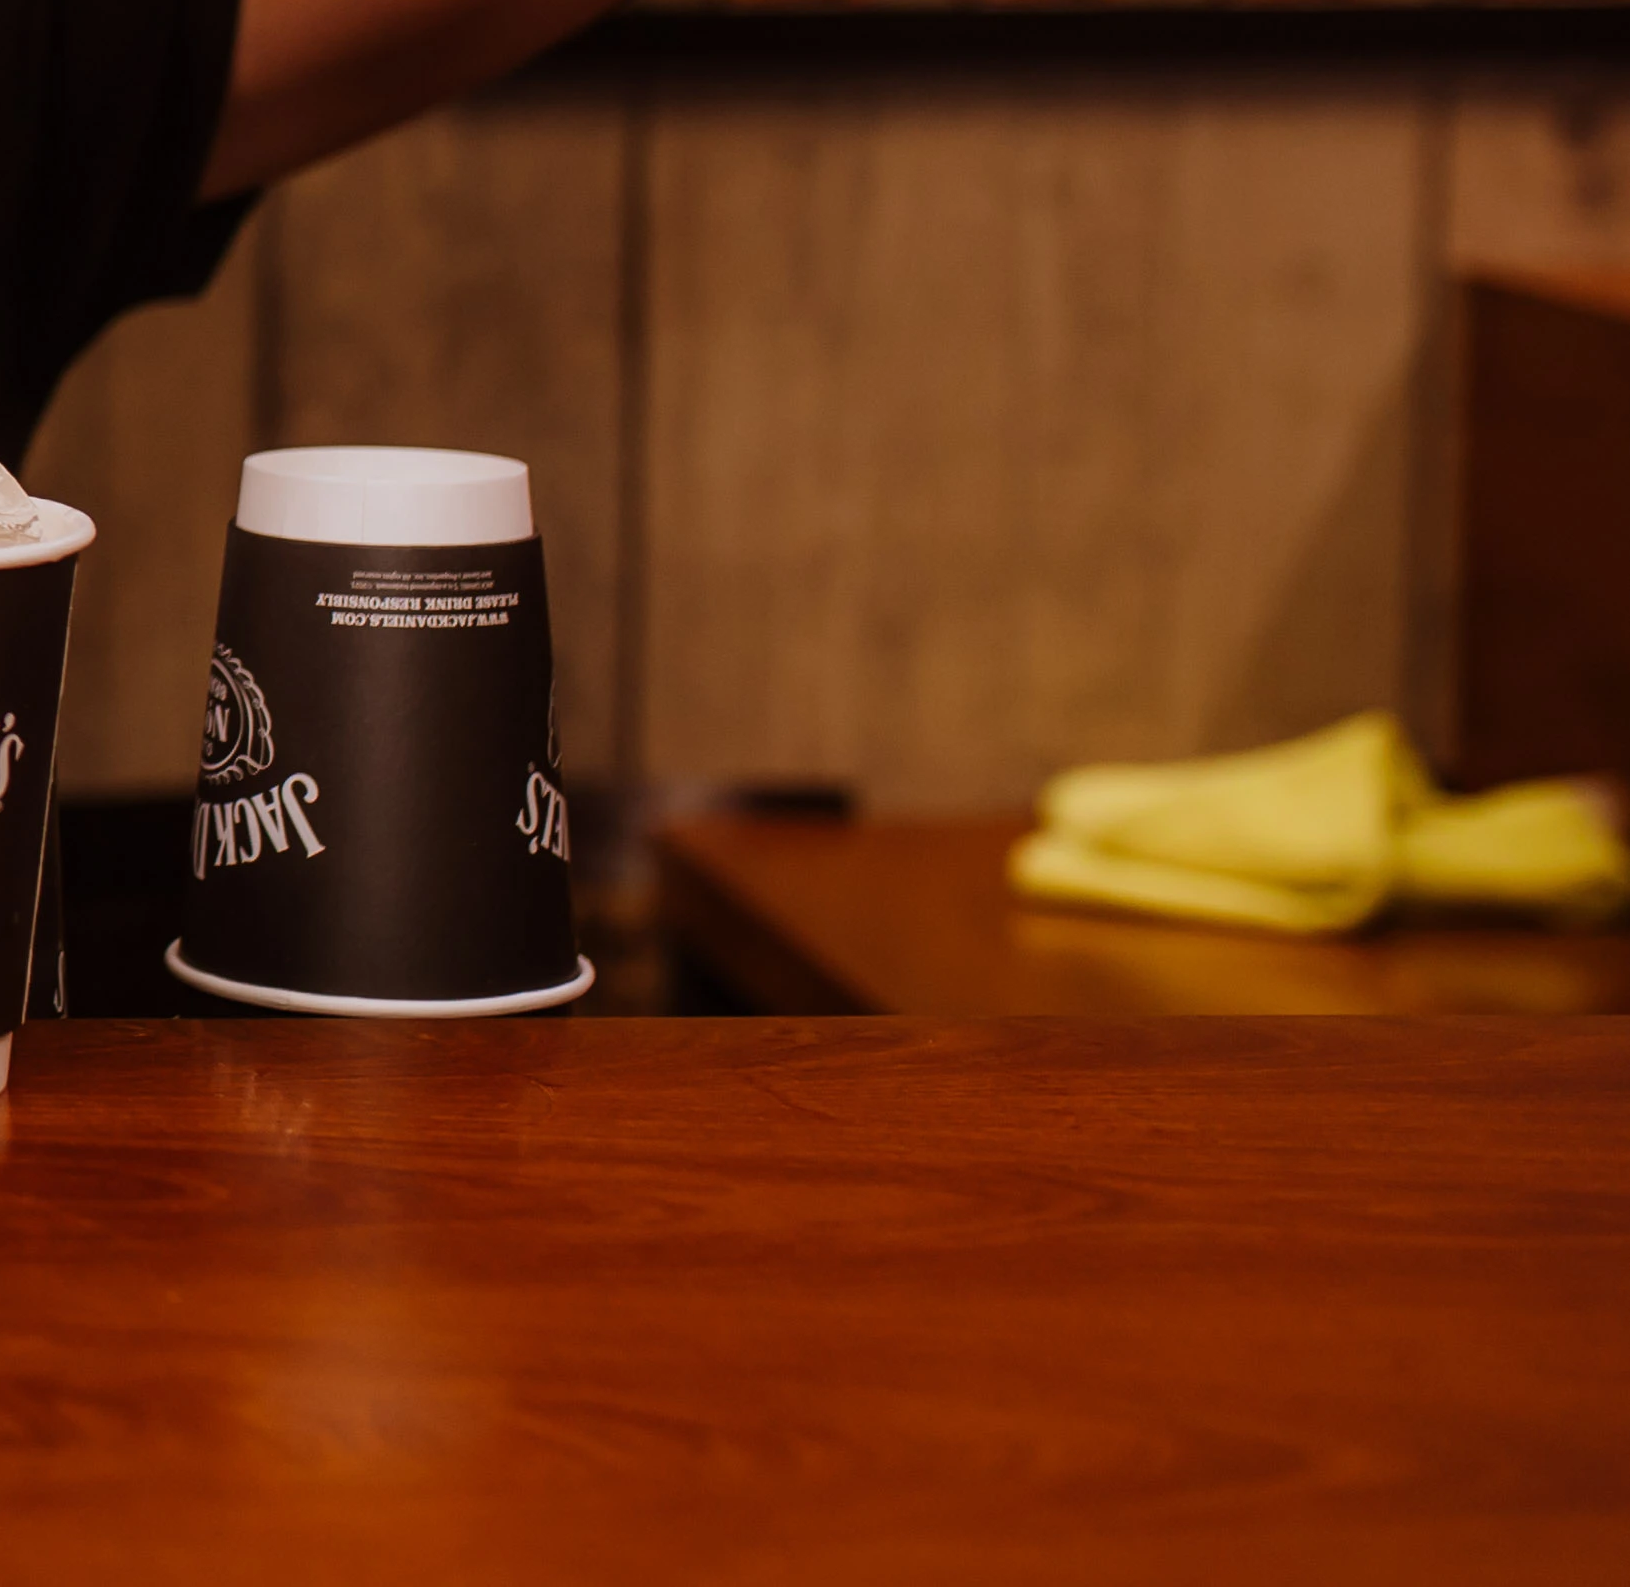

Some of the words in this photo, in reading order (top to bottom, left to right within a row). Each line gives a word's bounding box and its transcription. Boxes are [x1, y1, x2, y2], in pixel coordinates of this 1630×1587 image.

[315, 593, 421, 610] RESPONSIBLY
[424, 597, 472, 610] DRINK
[475, 592, 519, 609] PLEASE
[331, 611, 509, 628] WWW.JACKDANIELS.COM
[212, 772, 326, 867] JACK
